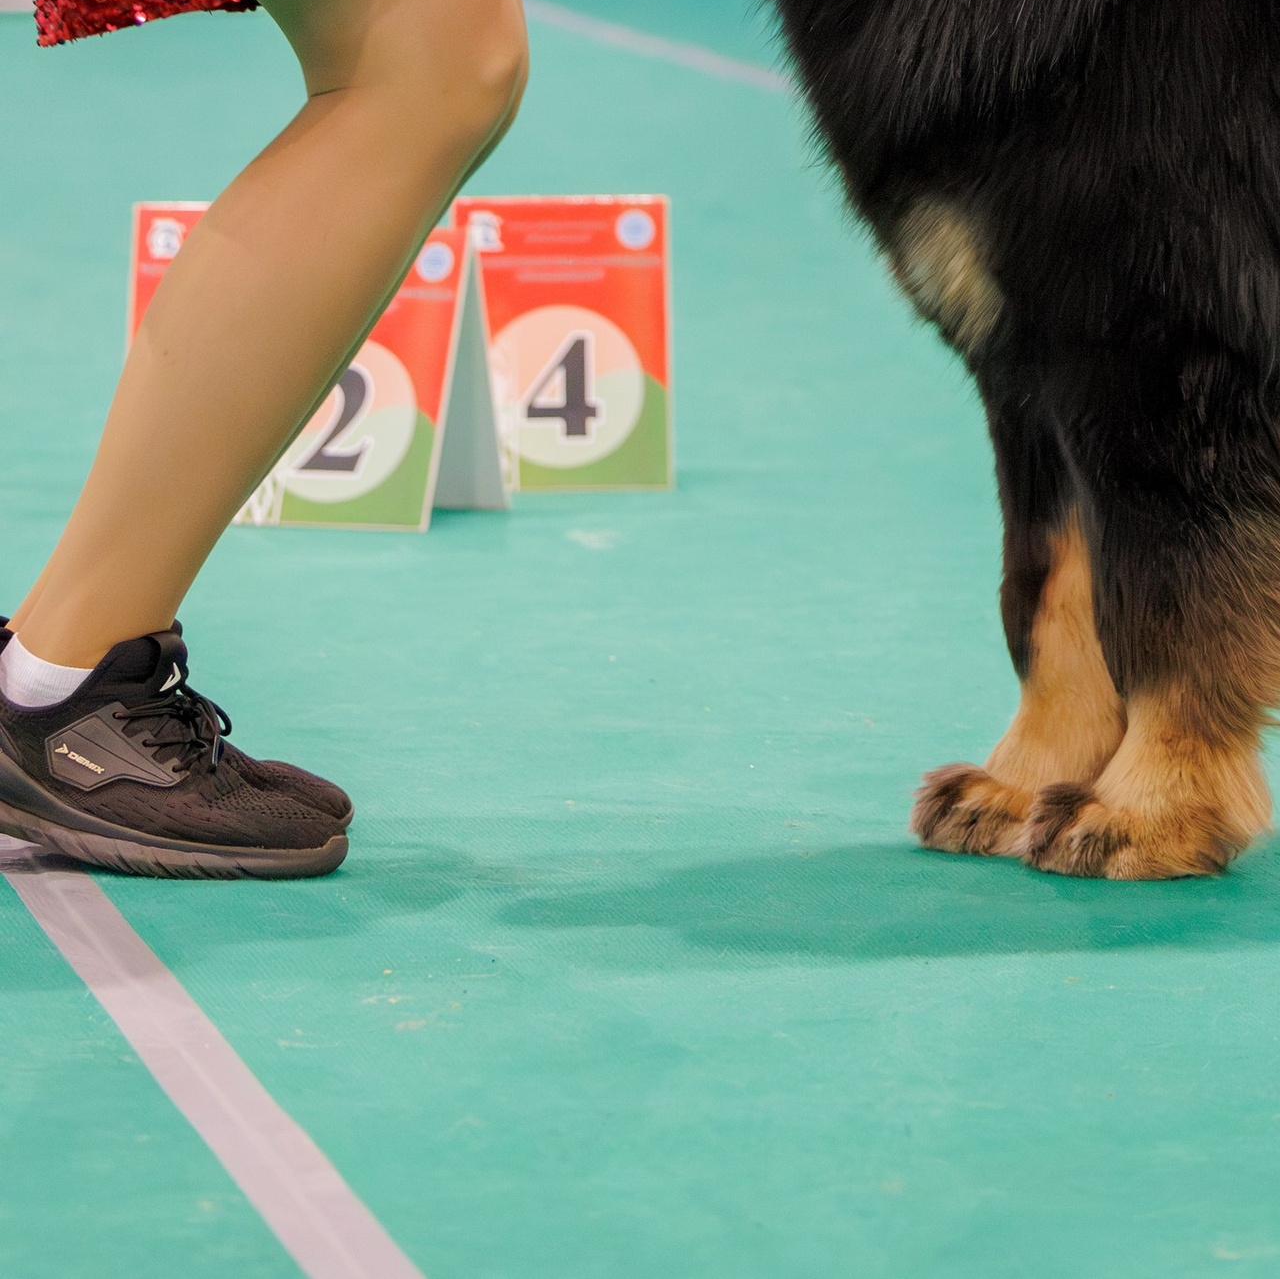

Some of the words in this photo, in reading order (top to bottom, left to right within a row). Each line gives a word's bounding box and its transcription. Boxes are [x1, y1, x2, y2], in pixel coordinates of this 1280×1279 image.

[296, 365, 368, 475] 2
[524, 334, 601, 440] 4
[67, 751, 105, 774] DEMIX
